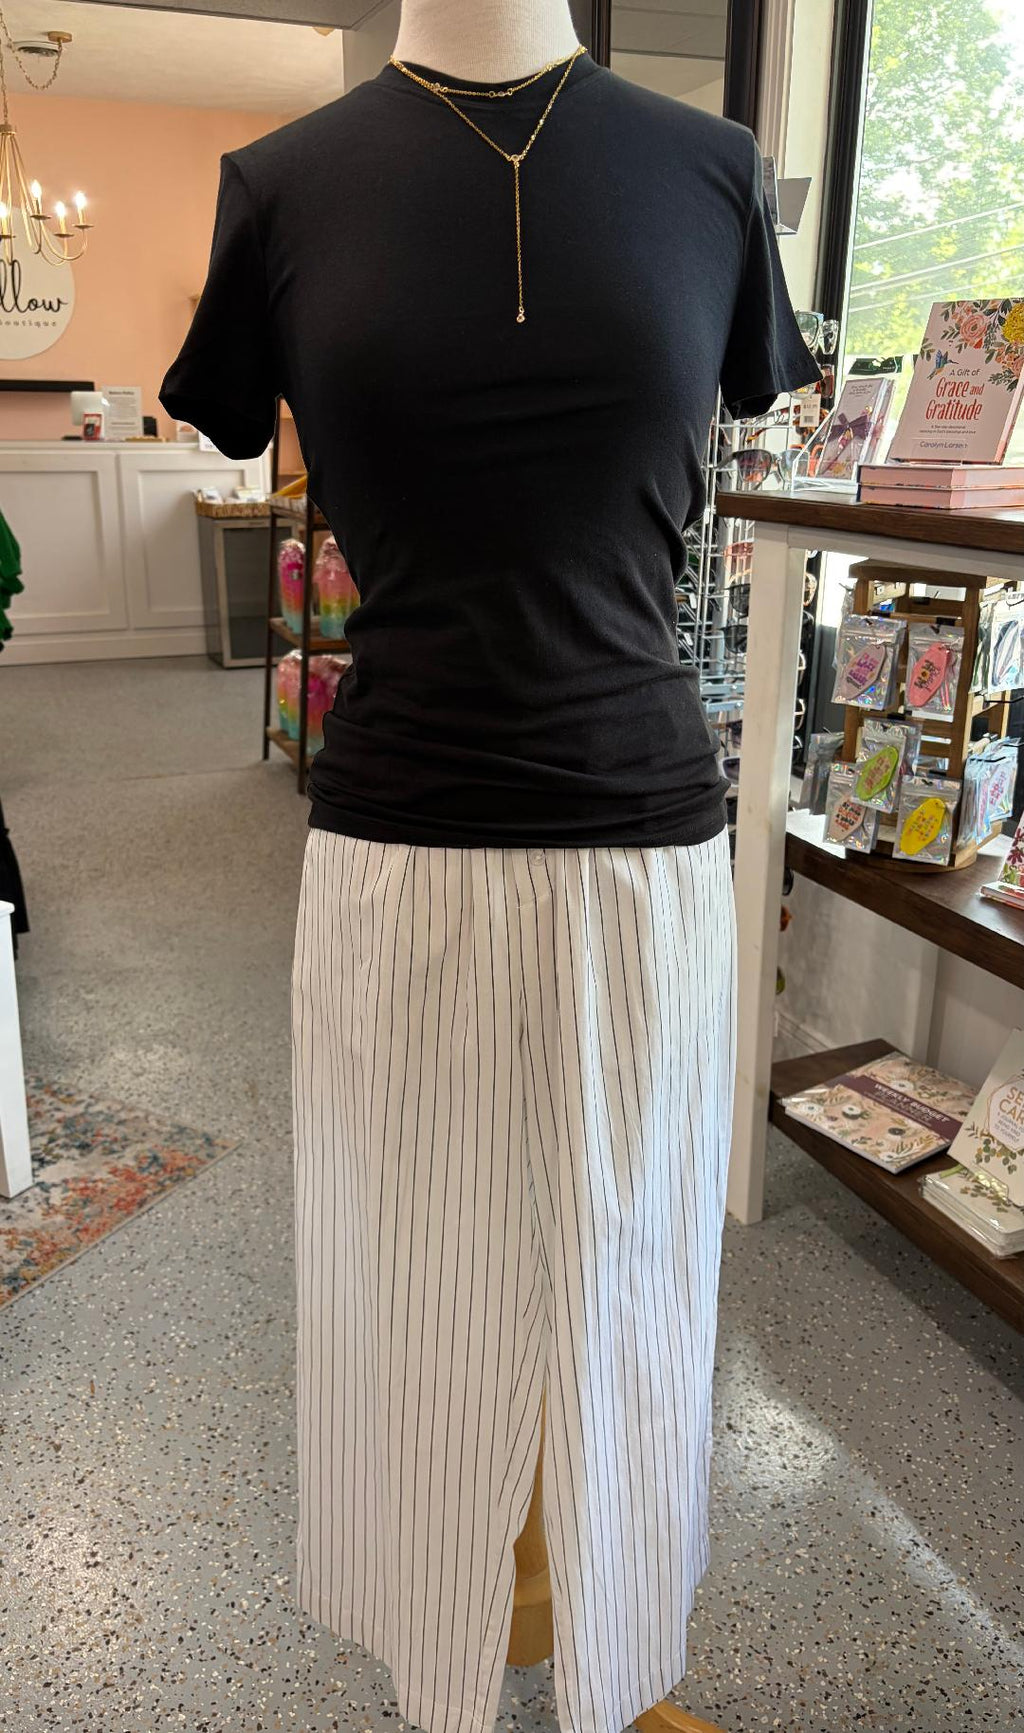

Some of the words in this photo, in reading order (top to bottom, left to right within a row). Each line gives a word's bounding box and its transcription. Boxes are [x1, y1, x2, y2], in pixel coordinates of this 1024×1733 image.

[957, 368, 971, 377] Gift
[971, 368, 982, 376] of
[935, 376, 970, 398] Grace
[969, 383, 985, 396] and
[925, 398, 983, 420] Gratitude
[919, 440, 944, 450] Carolyn
[874, 1083, 911, 1102] WEEKLY
[910, 1101, 951, 1123] BUDGET
